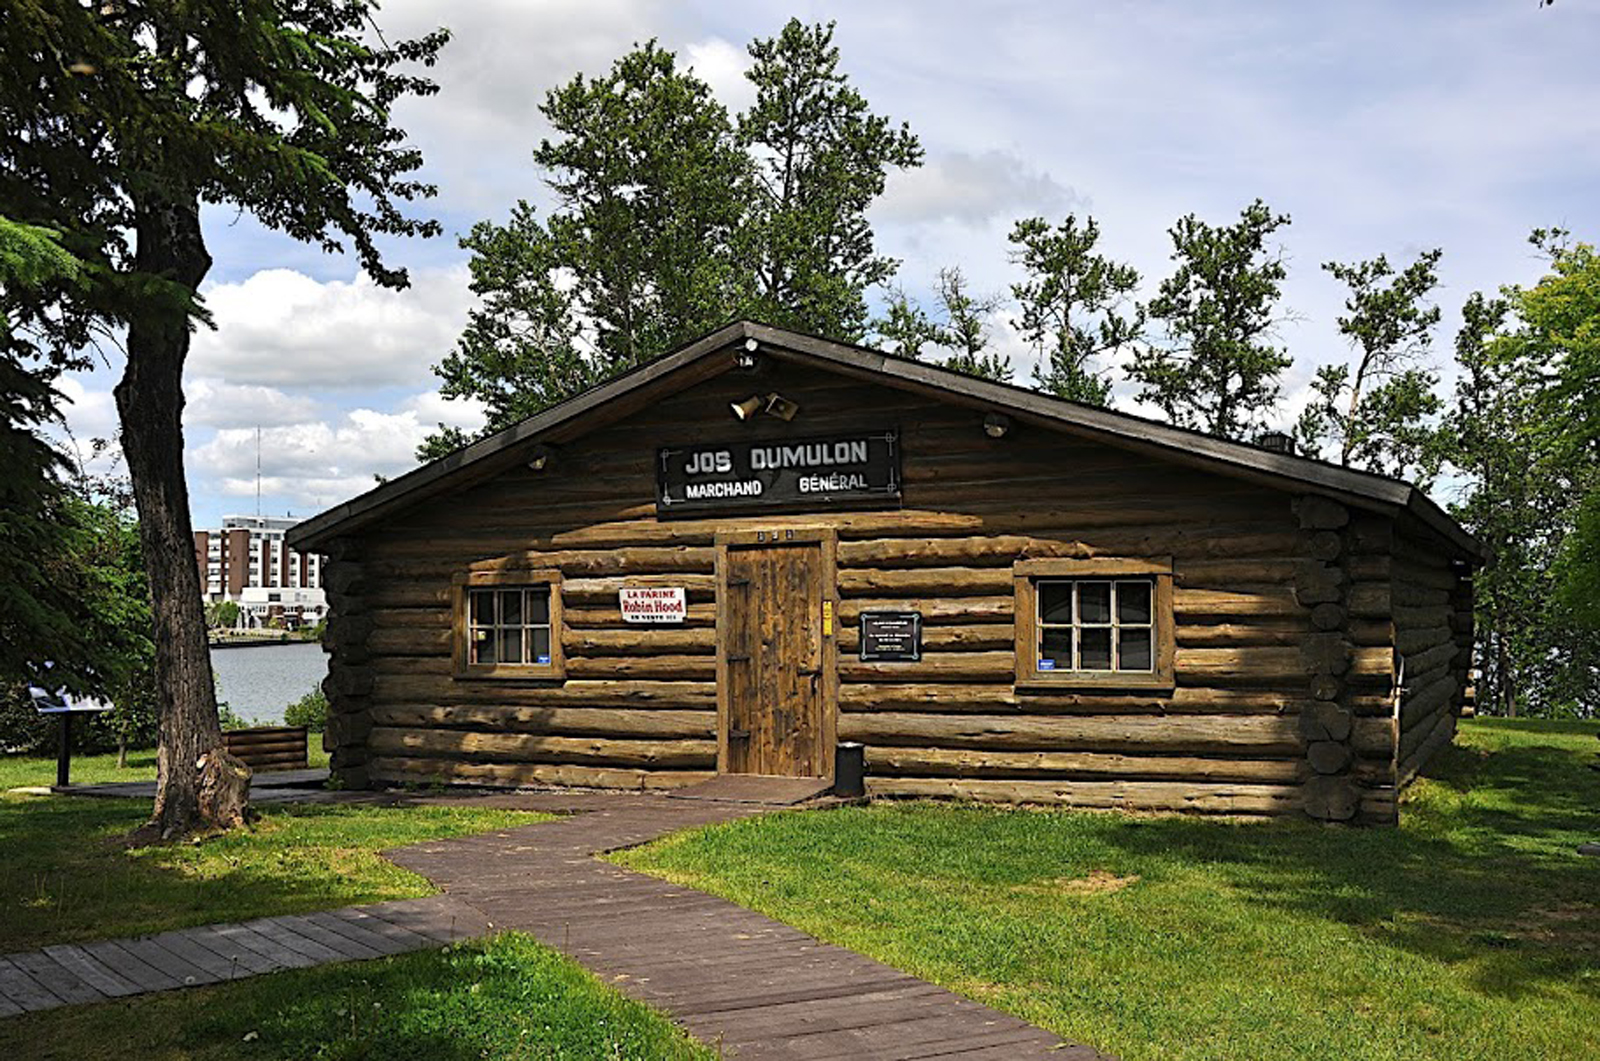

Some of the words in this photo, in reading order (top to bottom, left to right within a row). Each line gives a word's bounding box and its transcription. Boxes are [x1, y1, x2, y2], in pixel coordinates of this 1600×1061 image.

[685, 451, 732, 474] JOS
[751, 441, 868, 471] DUMULON
[686, 479, 762, 499] MARCHAND
[799, 472, 868, 493] GÉNÉRAL
[623, 599, 653, 612] Robin
[654, 599, 682, 613] Hood
